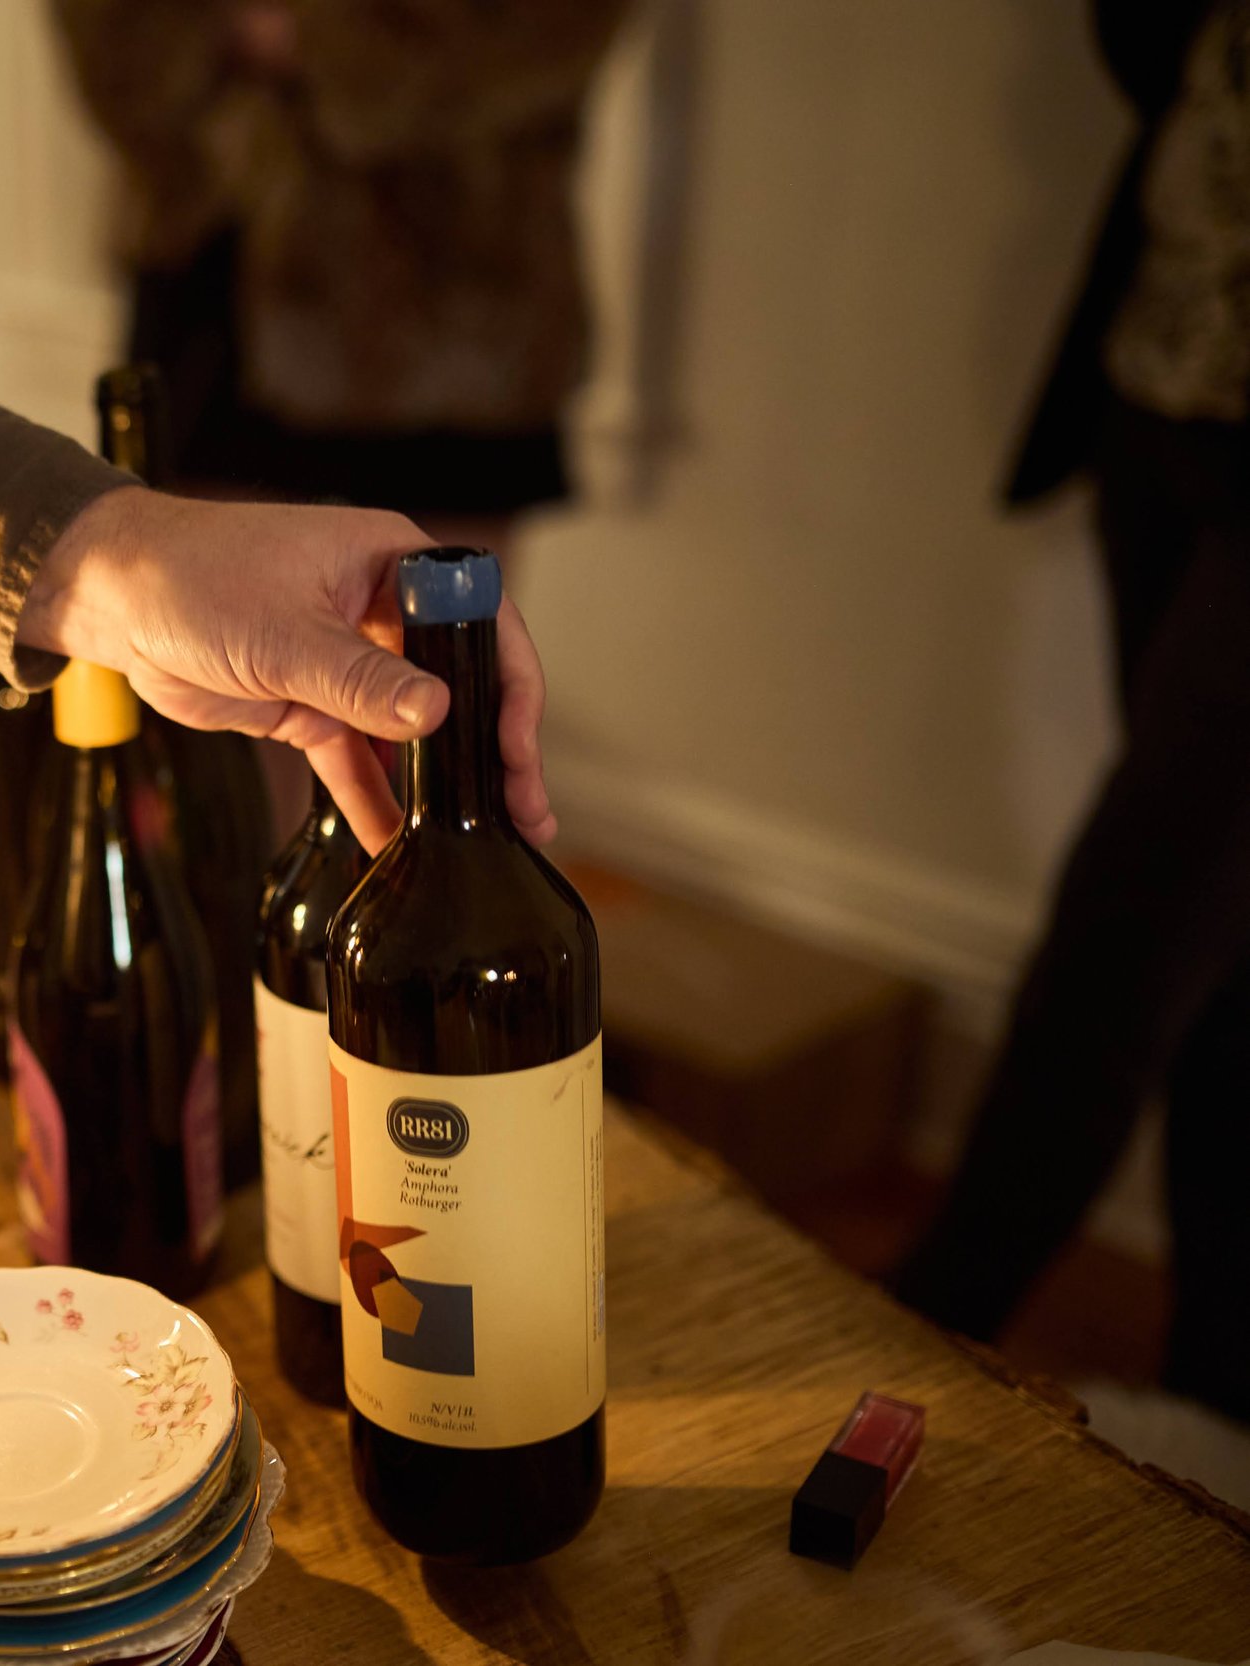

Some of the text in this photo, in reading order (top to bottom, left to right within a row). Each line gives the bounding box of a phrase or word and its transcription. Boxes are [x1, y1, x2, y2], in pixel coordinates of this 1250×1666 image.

[400, 1115, 453, 1141] RR81
[404, 1159, 452, 1178] 'Solera'
[400, 1176, 459, 1195] Amphora
[400, 1191, 462, 1213] Rotburger
